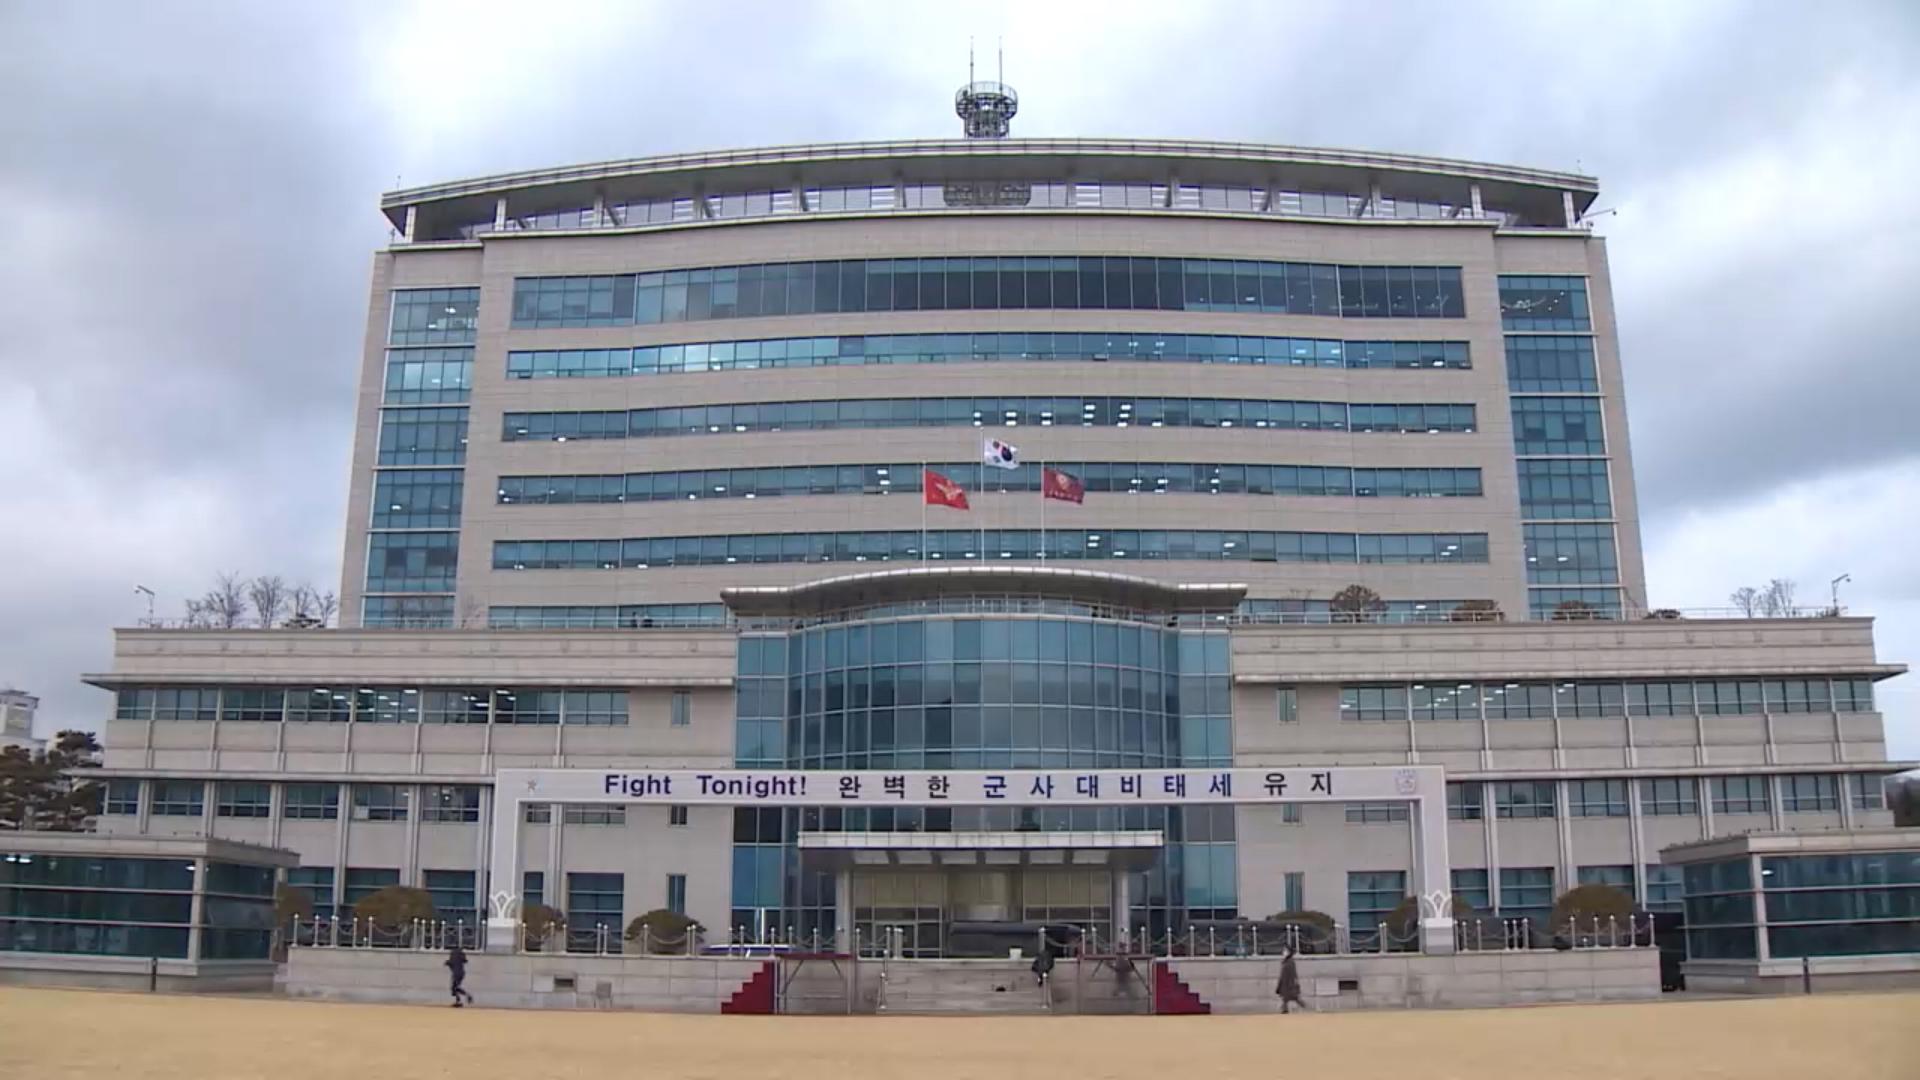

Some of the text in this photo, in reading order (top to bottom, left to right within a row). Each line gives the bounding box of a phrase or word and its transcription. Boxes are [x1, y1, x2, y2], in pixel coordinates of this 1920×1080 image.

[604, 771, 1332, 800] Fight Tonight! 완벽한 군사대비태세 유지
